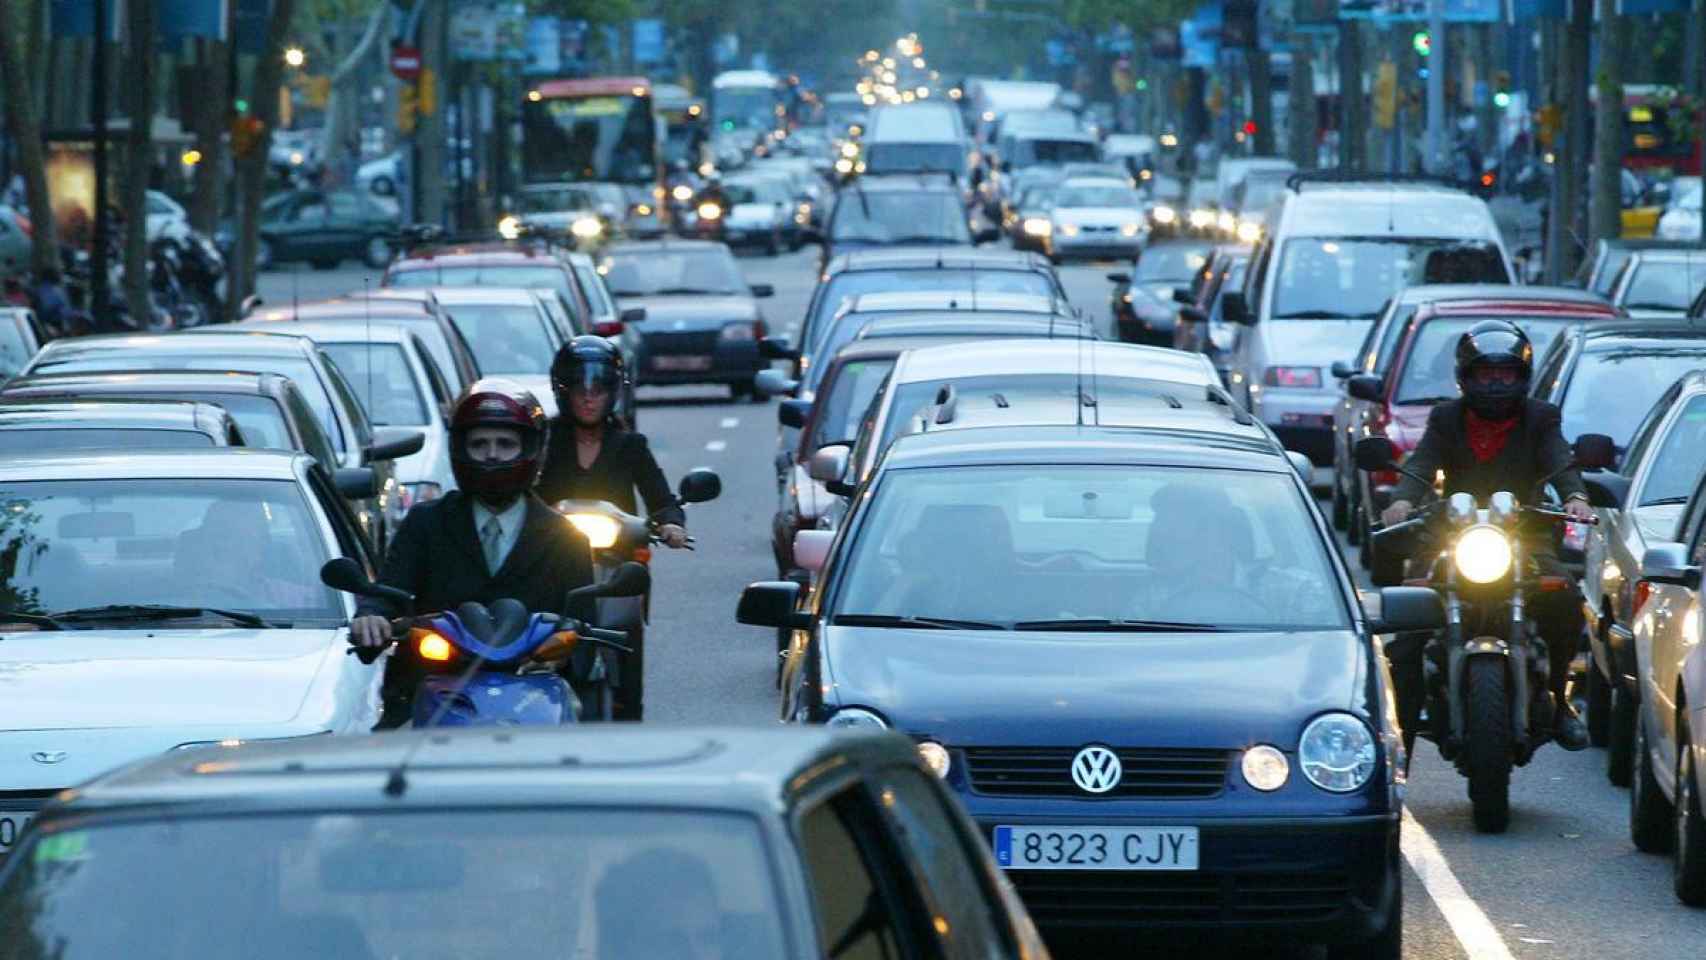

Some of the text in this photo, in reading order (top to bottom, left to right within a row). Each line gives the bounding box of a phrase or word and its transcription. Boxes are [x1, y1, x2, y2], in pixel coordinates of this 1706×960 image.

[1072, 748, 1122, 793] VW
[1024, 832, 1185, 864] 8323 CJY
